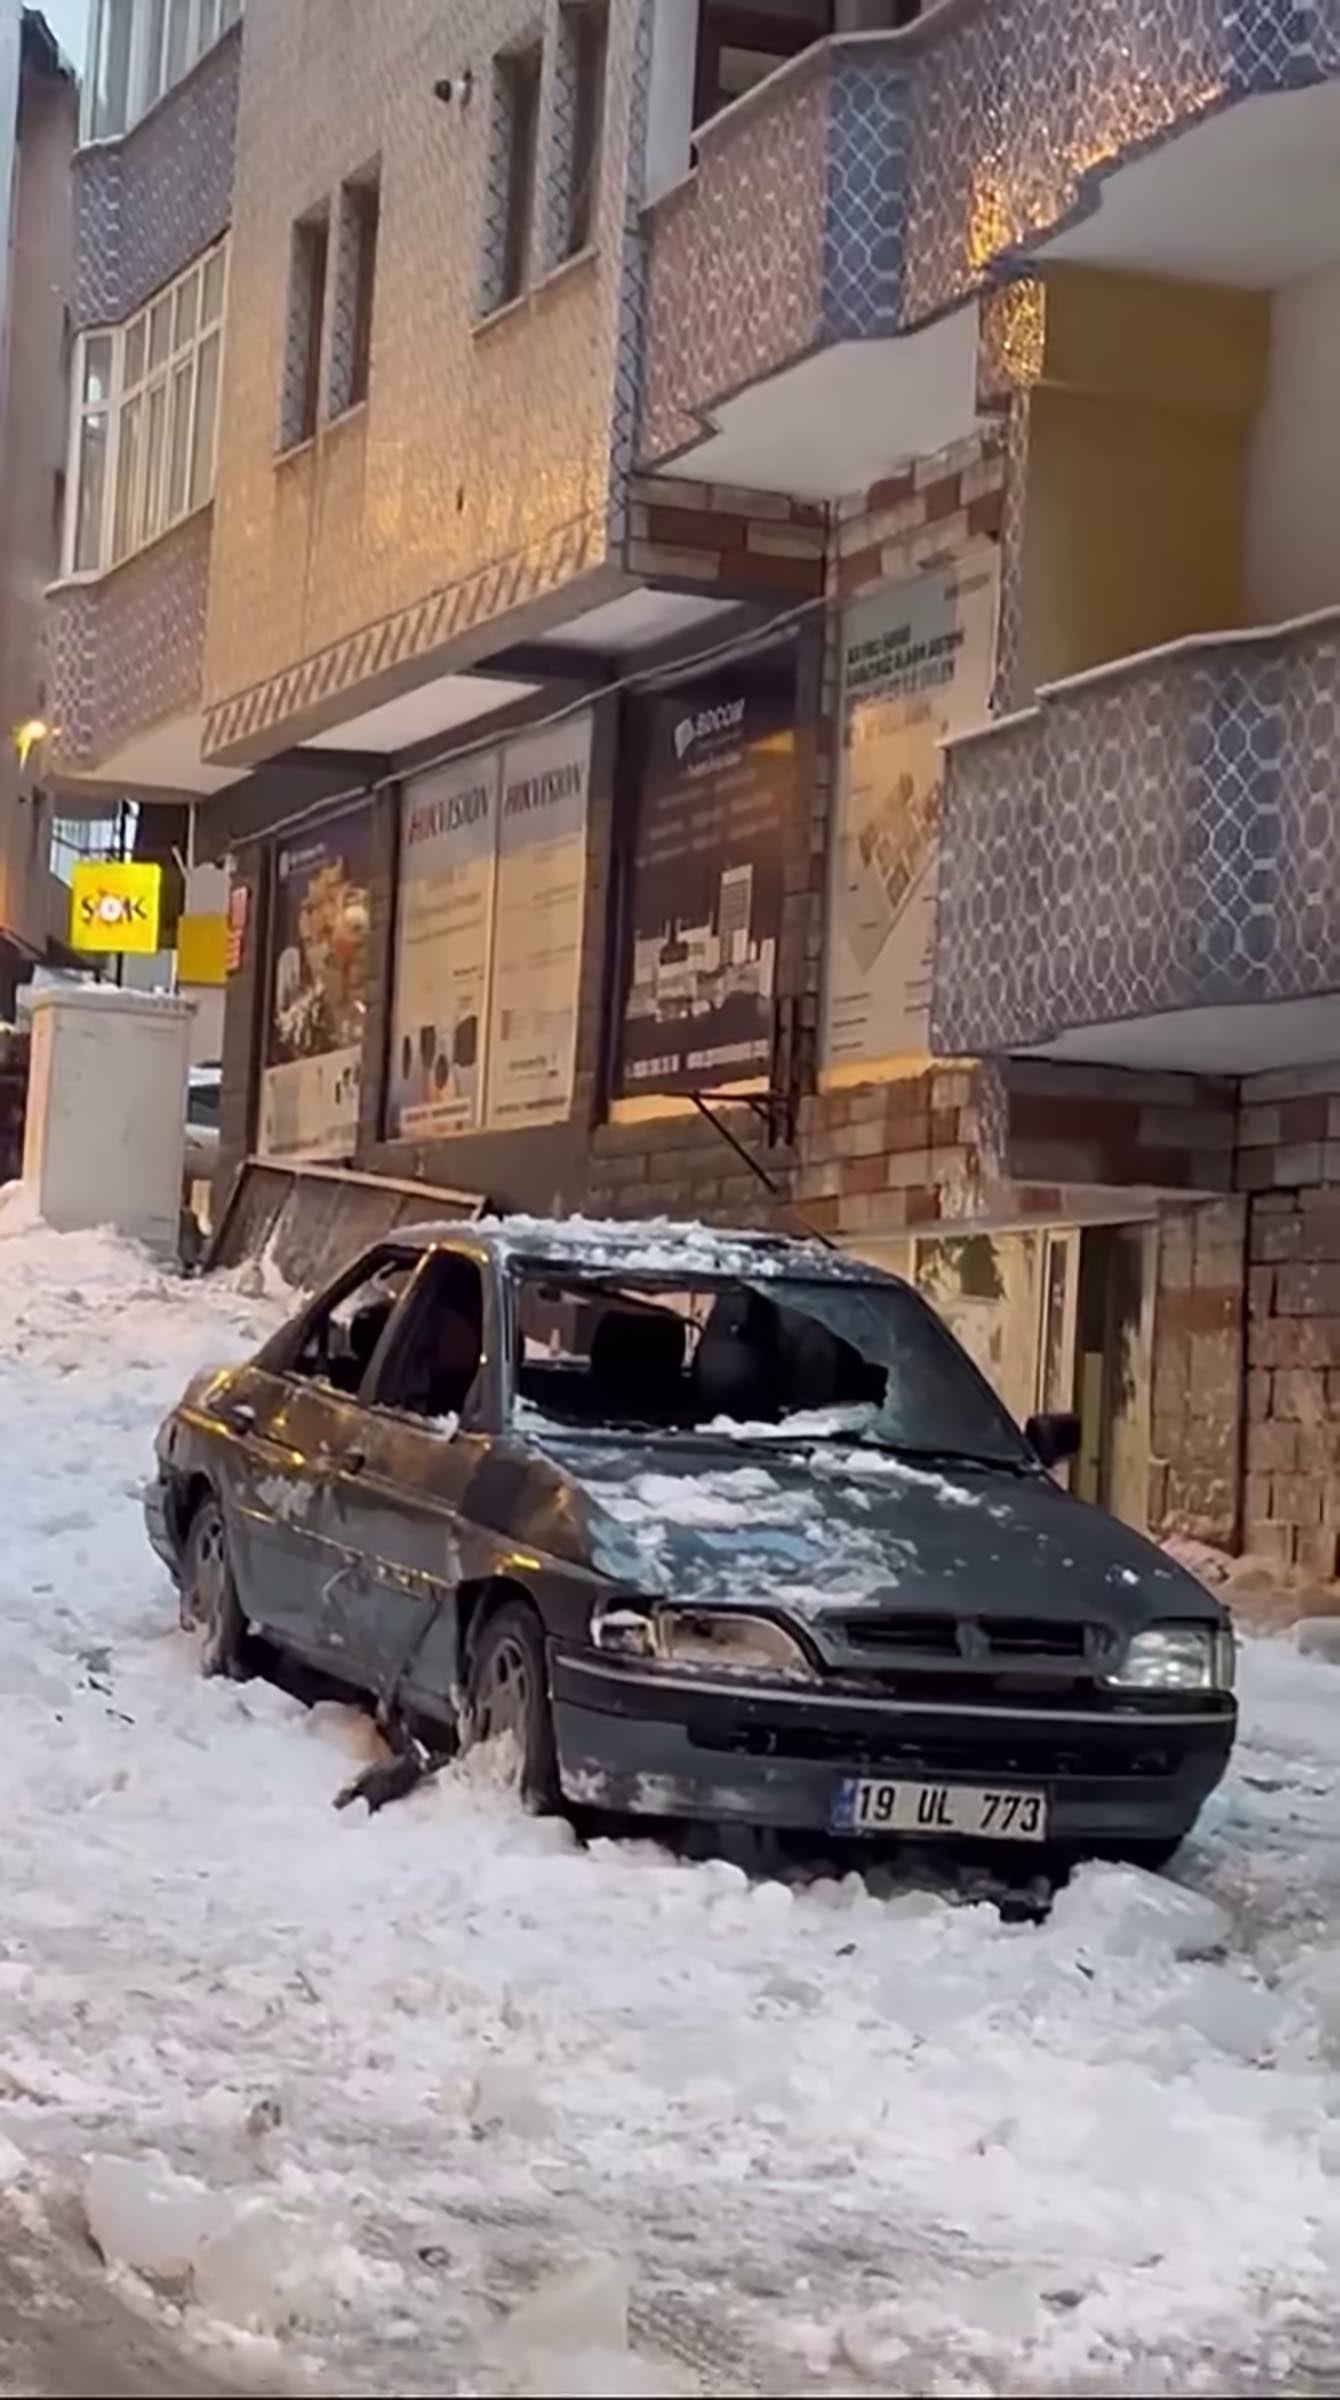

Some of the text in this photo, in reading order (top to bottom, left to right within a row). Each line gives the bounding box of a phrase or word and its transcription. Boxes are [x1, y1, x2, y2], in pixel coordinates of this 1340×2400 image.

[408, 783, 488, 846] HIKVISION
[504, 762, 582, 820] HIKVISION
[860, 1785, 1042, 1832] 19 UL 773
